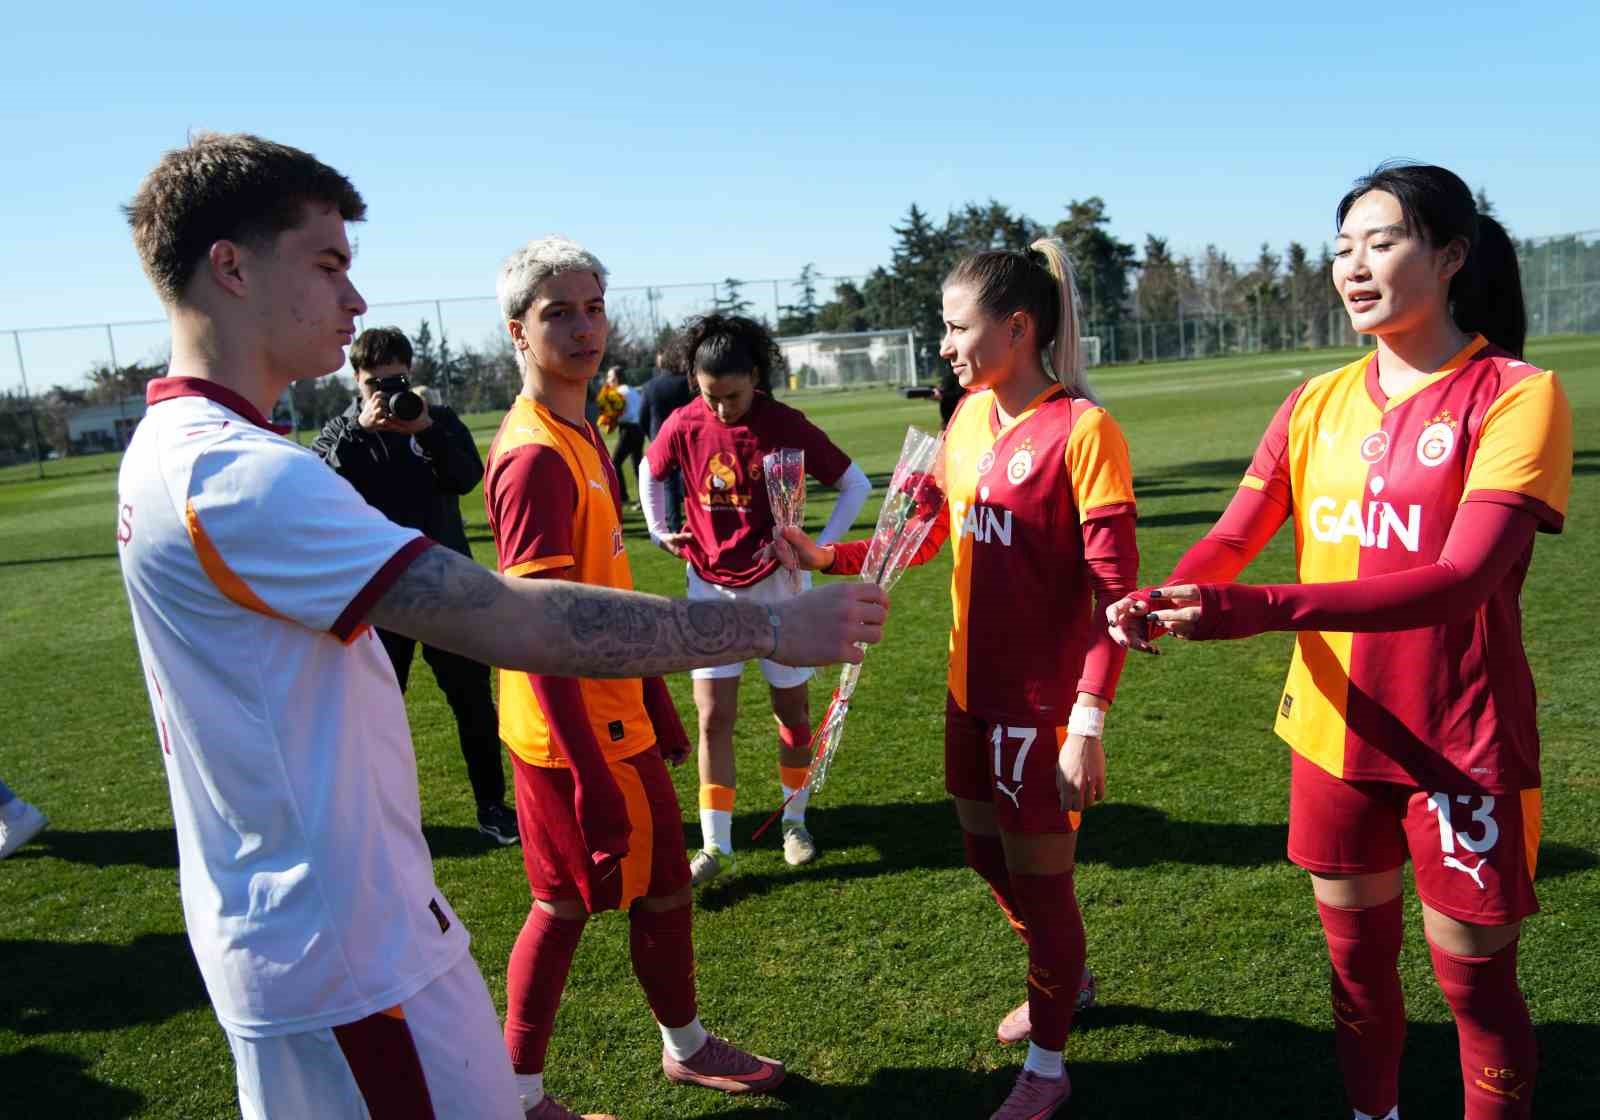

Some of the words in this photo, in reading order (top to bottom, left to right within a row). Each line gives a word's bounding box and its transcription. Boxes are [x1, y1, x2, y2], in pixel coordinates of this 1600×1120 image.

[1308, 495, 1422, 553] GAIN
[990, 723, 1038, 782] 17
[1426, 791, 1499, 853] 13
